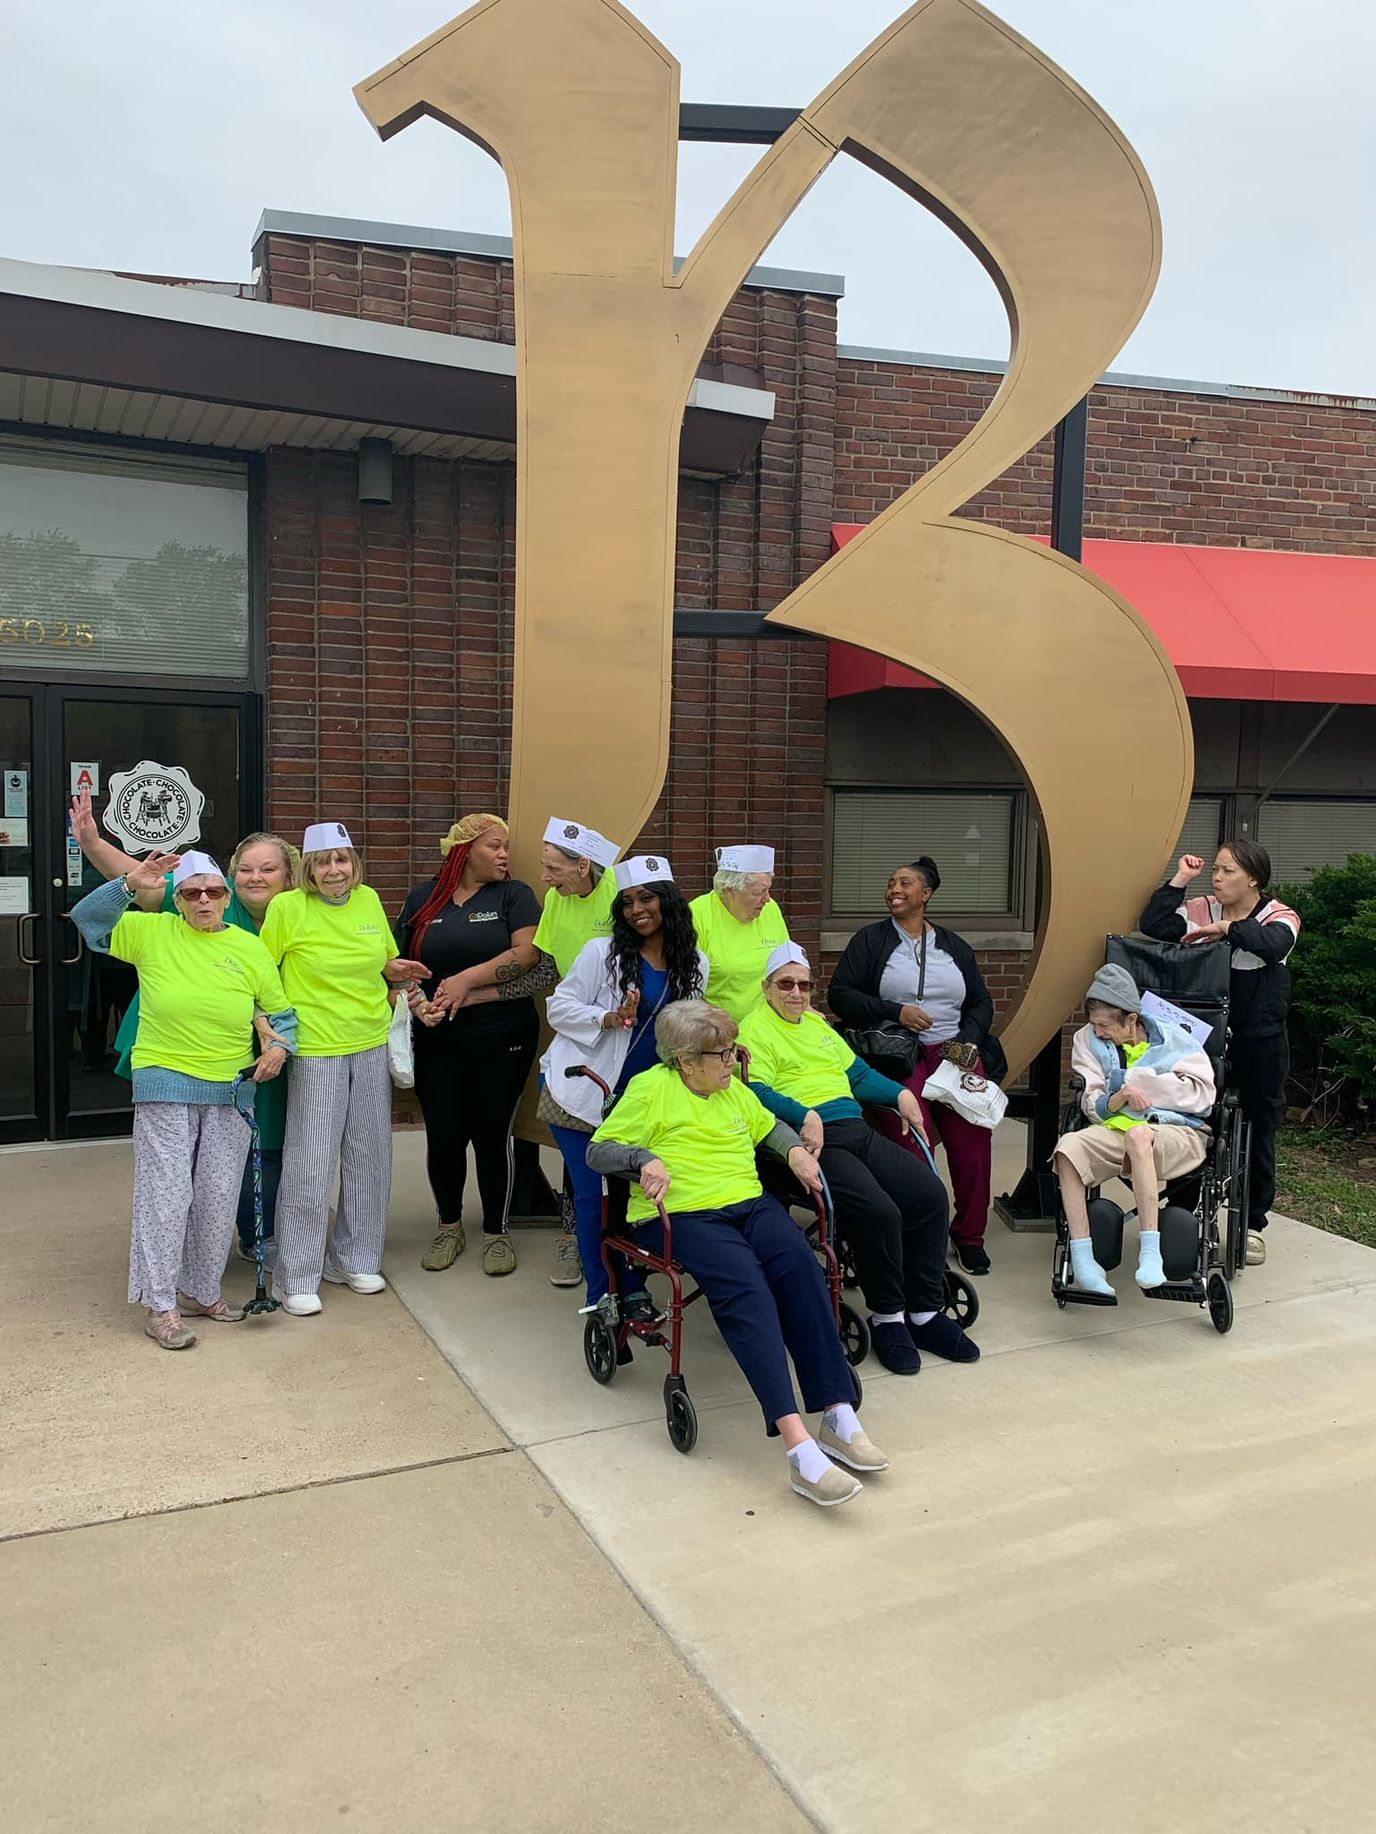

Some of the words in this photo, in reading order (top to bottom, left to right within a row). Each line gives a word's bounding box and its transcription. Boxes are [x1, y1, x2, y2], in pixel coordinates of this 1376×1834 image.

[0, 618, 94, 648] 5025
[77, 770, 93, 785] A
[122, 779, 153, 821] CHOCOLATE
[156, 779, 186, 823] CHOCOLATE
[129, 822, 179, 838] CHOCOLATE
